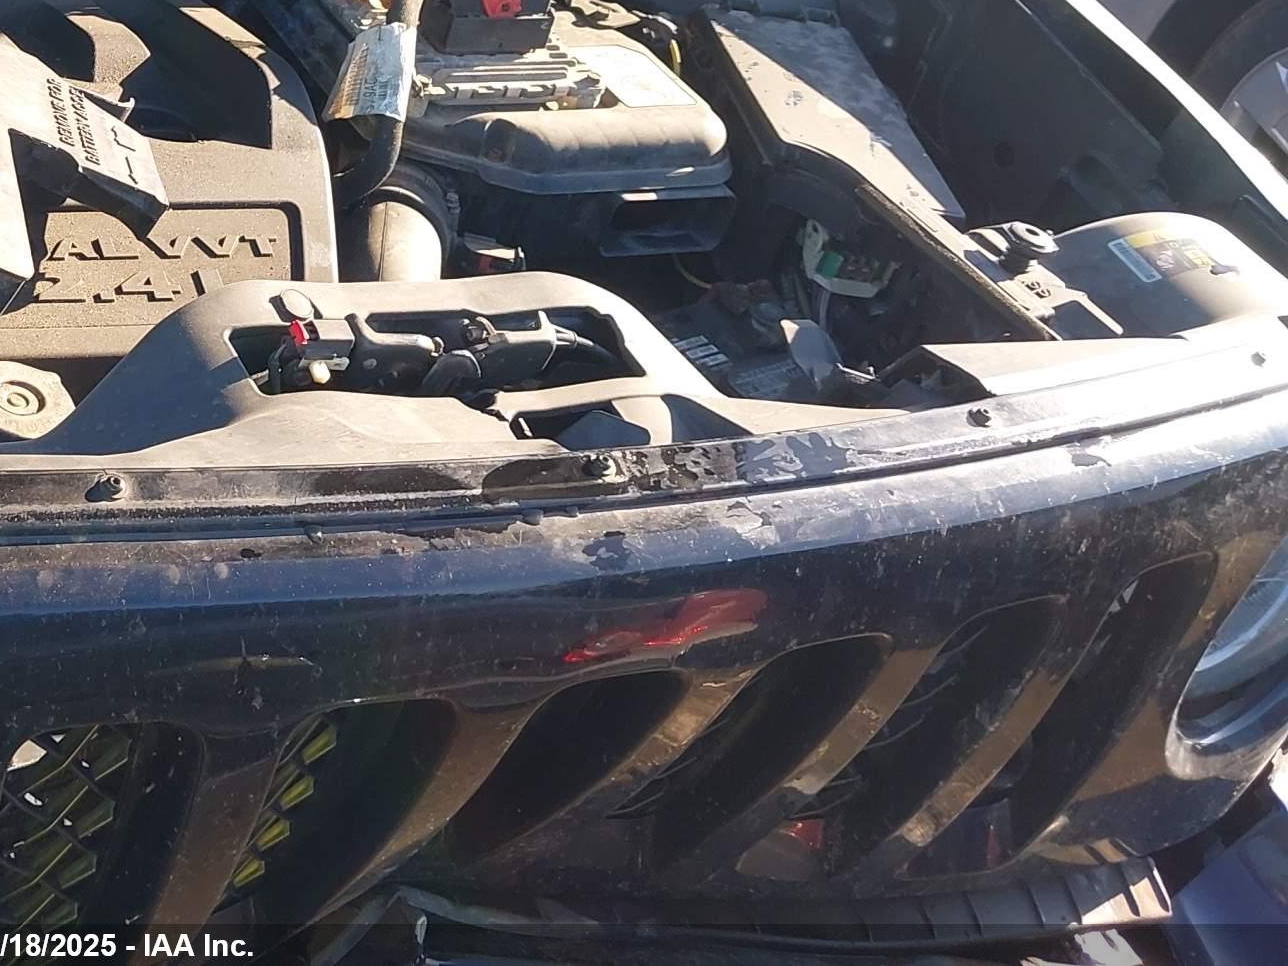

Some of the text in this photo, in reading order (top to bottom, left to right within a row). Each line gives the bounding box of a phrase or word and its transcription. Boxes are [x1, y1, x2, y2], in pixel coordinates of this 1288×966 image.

[46, 78, 75, 147] REMOVE FOR
[68, 86, 102, 166] BATTERY ACCE
[144, 234, 277, 260] VVT
